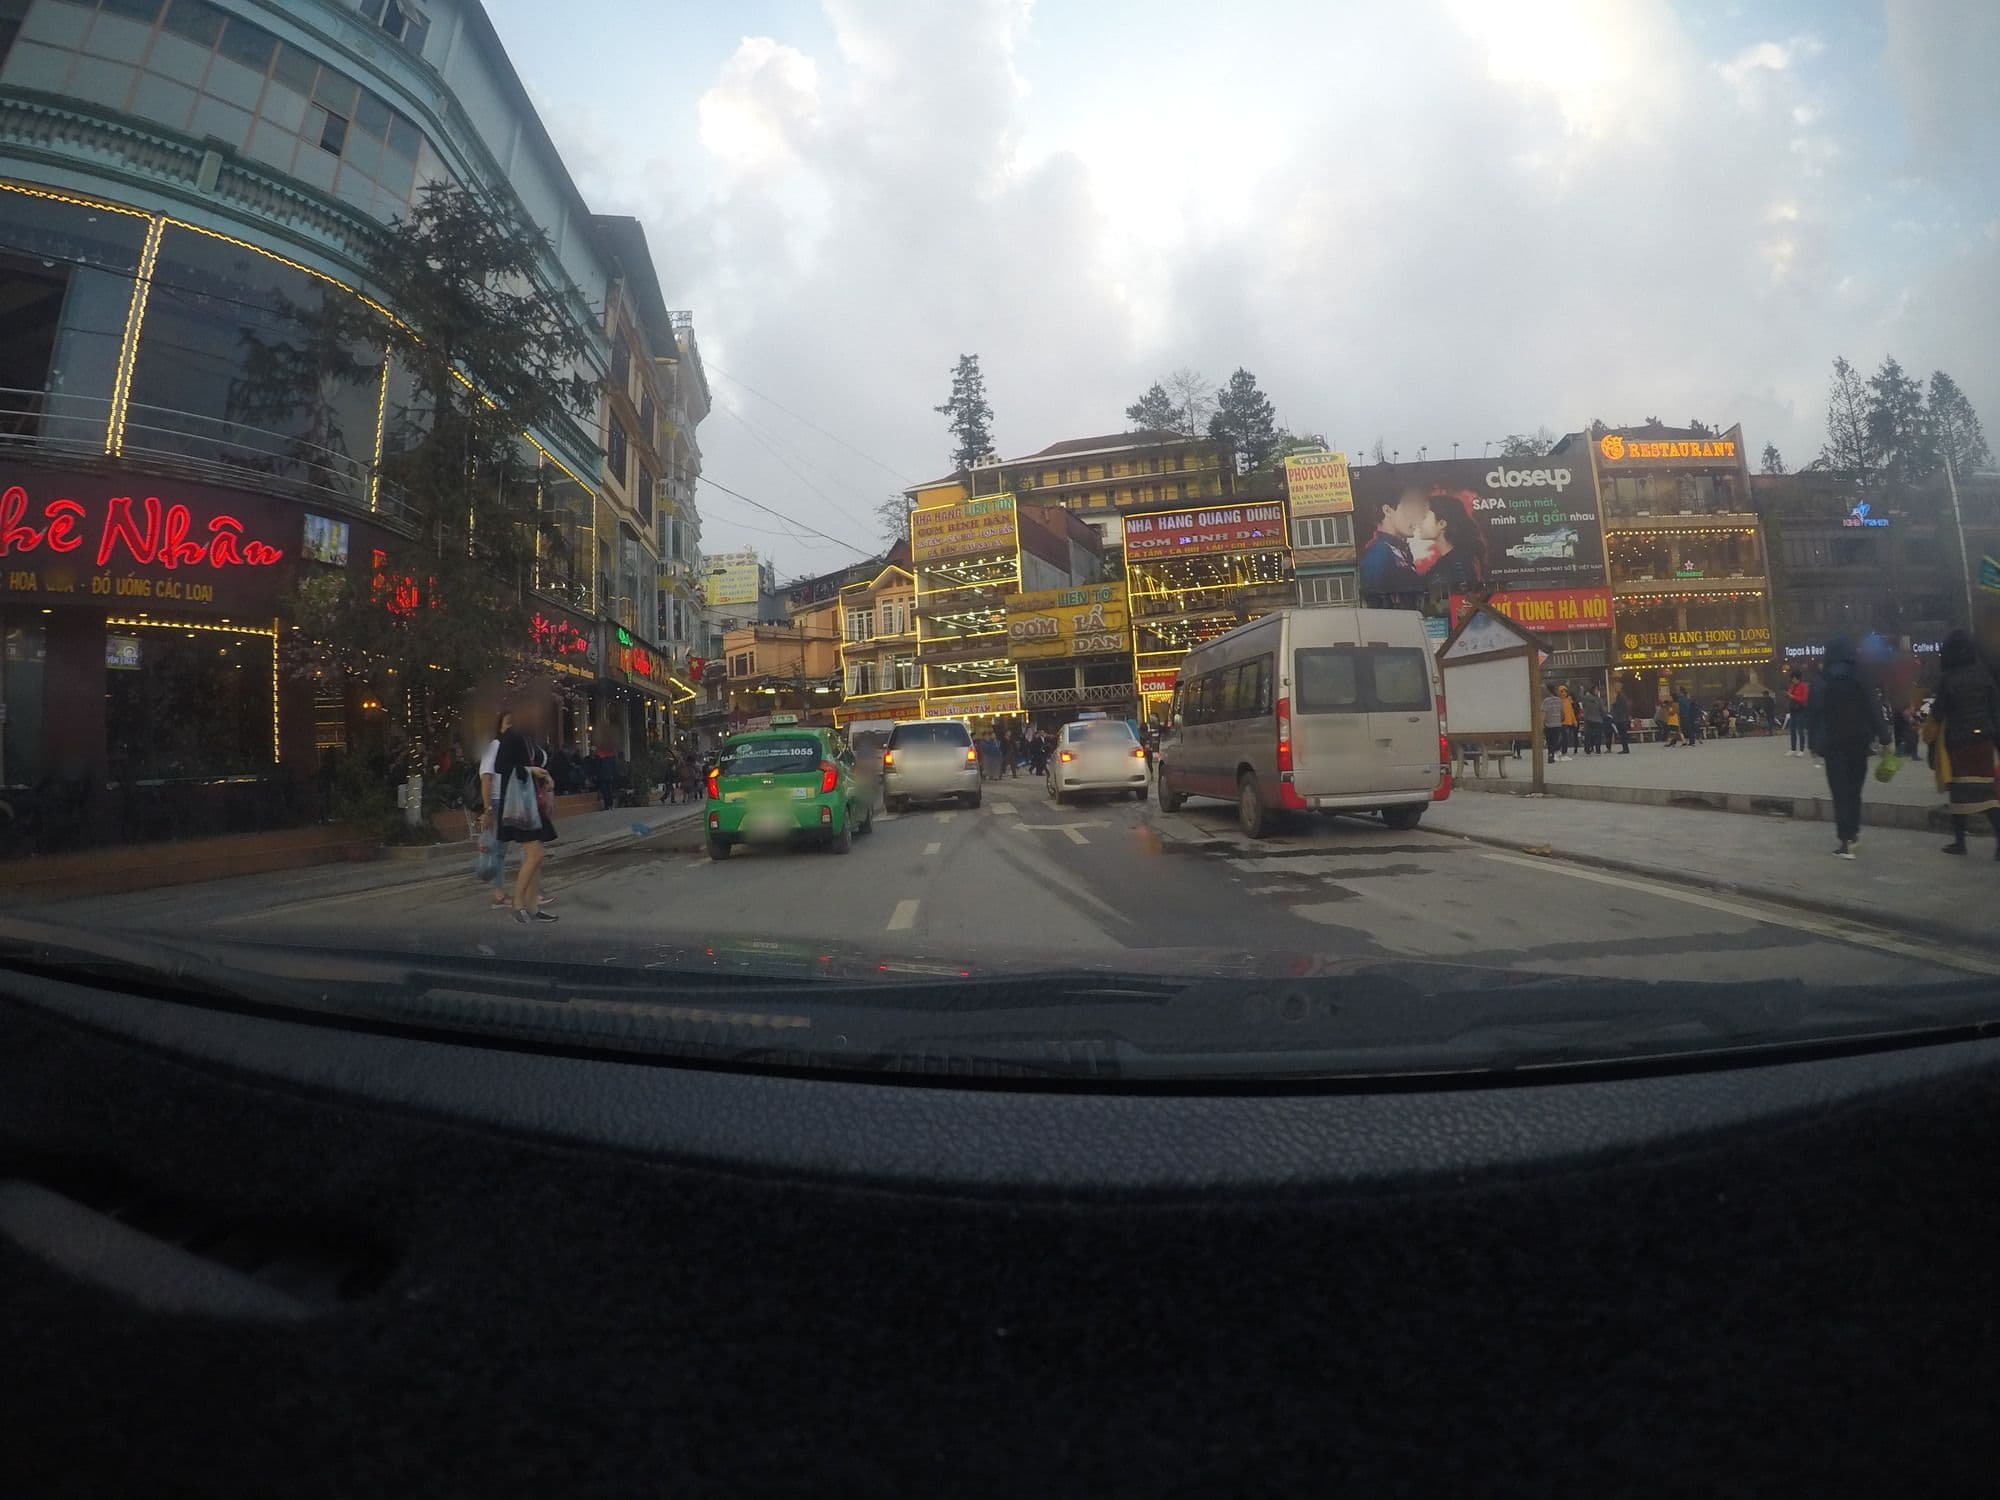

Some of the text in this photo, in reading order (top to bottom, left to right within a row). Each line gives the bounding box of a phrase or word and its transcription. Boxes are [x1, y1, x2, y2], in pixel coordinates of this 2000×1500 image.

[1628, 442, 1735, 458] RESTAURANT
[1288, 463, 1346, 482] PHOTOCOPY
[1486, 466, 1571, 492] closeup
[1472, 498, 1506, 510] SAPA
[1198, 509, 1241, 526] QUANG
[1570, 512, 1595, 521] nhau
[96, 497, 283, 569] Nhân
[9, 571, 37, 592] HOA
[156, 577, 182, 599] CÁC
[1516, 597, 1555, 621] TÙNG
[1559, 595, 1579, 619] HÀ
[1582, 593, 1608, 621] NỘI
[1010, 617, 1058, 639] CƠM
[1740, 628, 1770, 641] LONG
[1073, 633, 1122, 653] DÂN
[1785, 646, 1805, 658] Tapas
[790, 747, 813, 756] 1055
